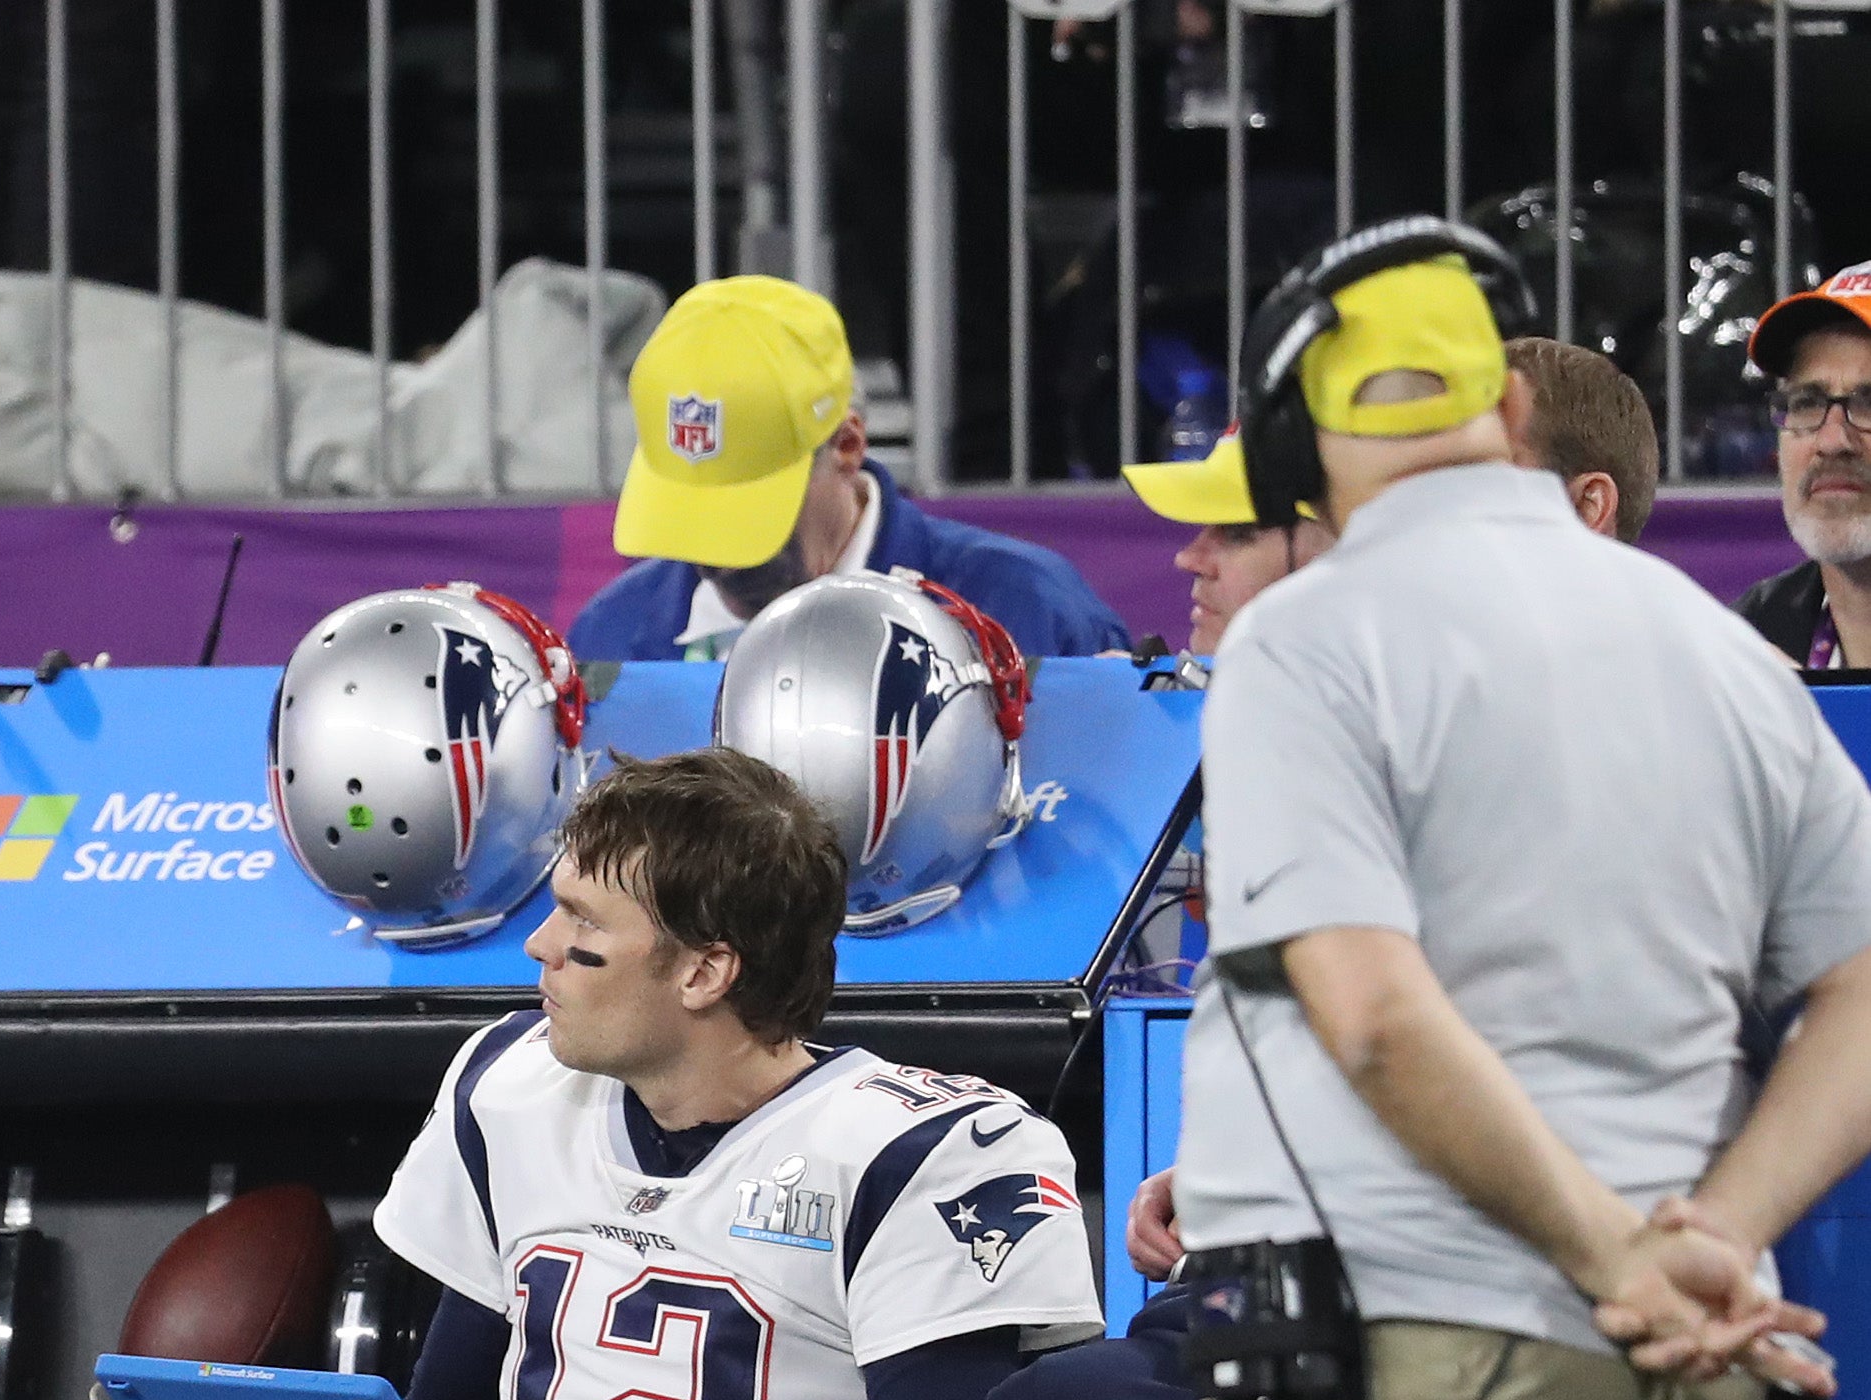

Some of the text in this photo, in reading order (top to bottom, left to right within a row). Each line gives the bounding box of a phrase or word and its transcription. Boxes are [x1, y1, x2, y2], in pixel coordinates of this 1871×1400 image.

[91, 792, 278, 833] Micros
[62, 838, 277, 882] Surface
[591, 1223, 677, 1251] PATRIOTS
